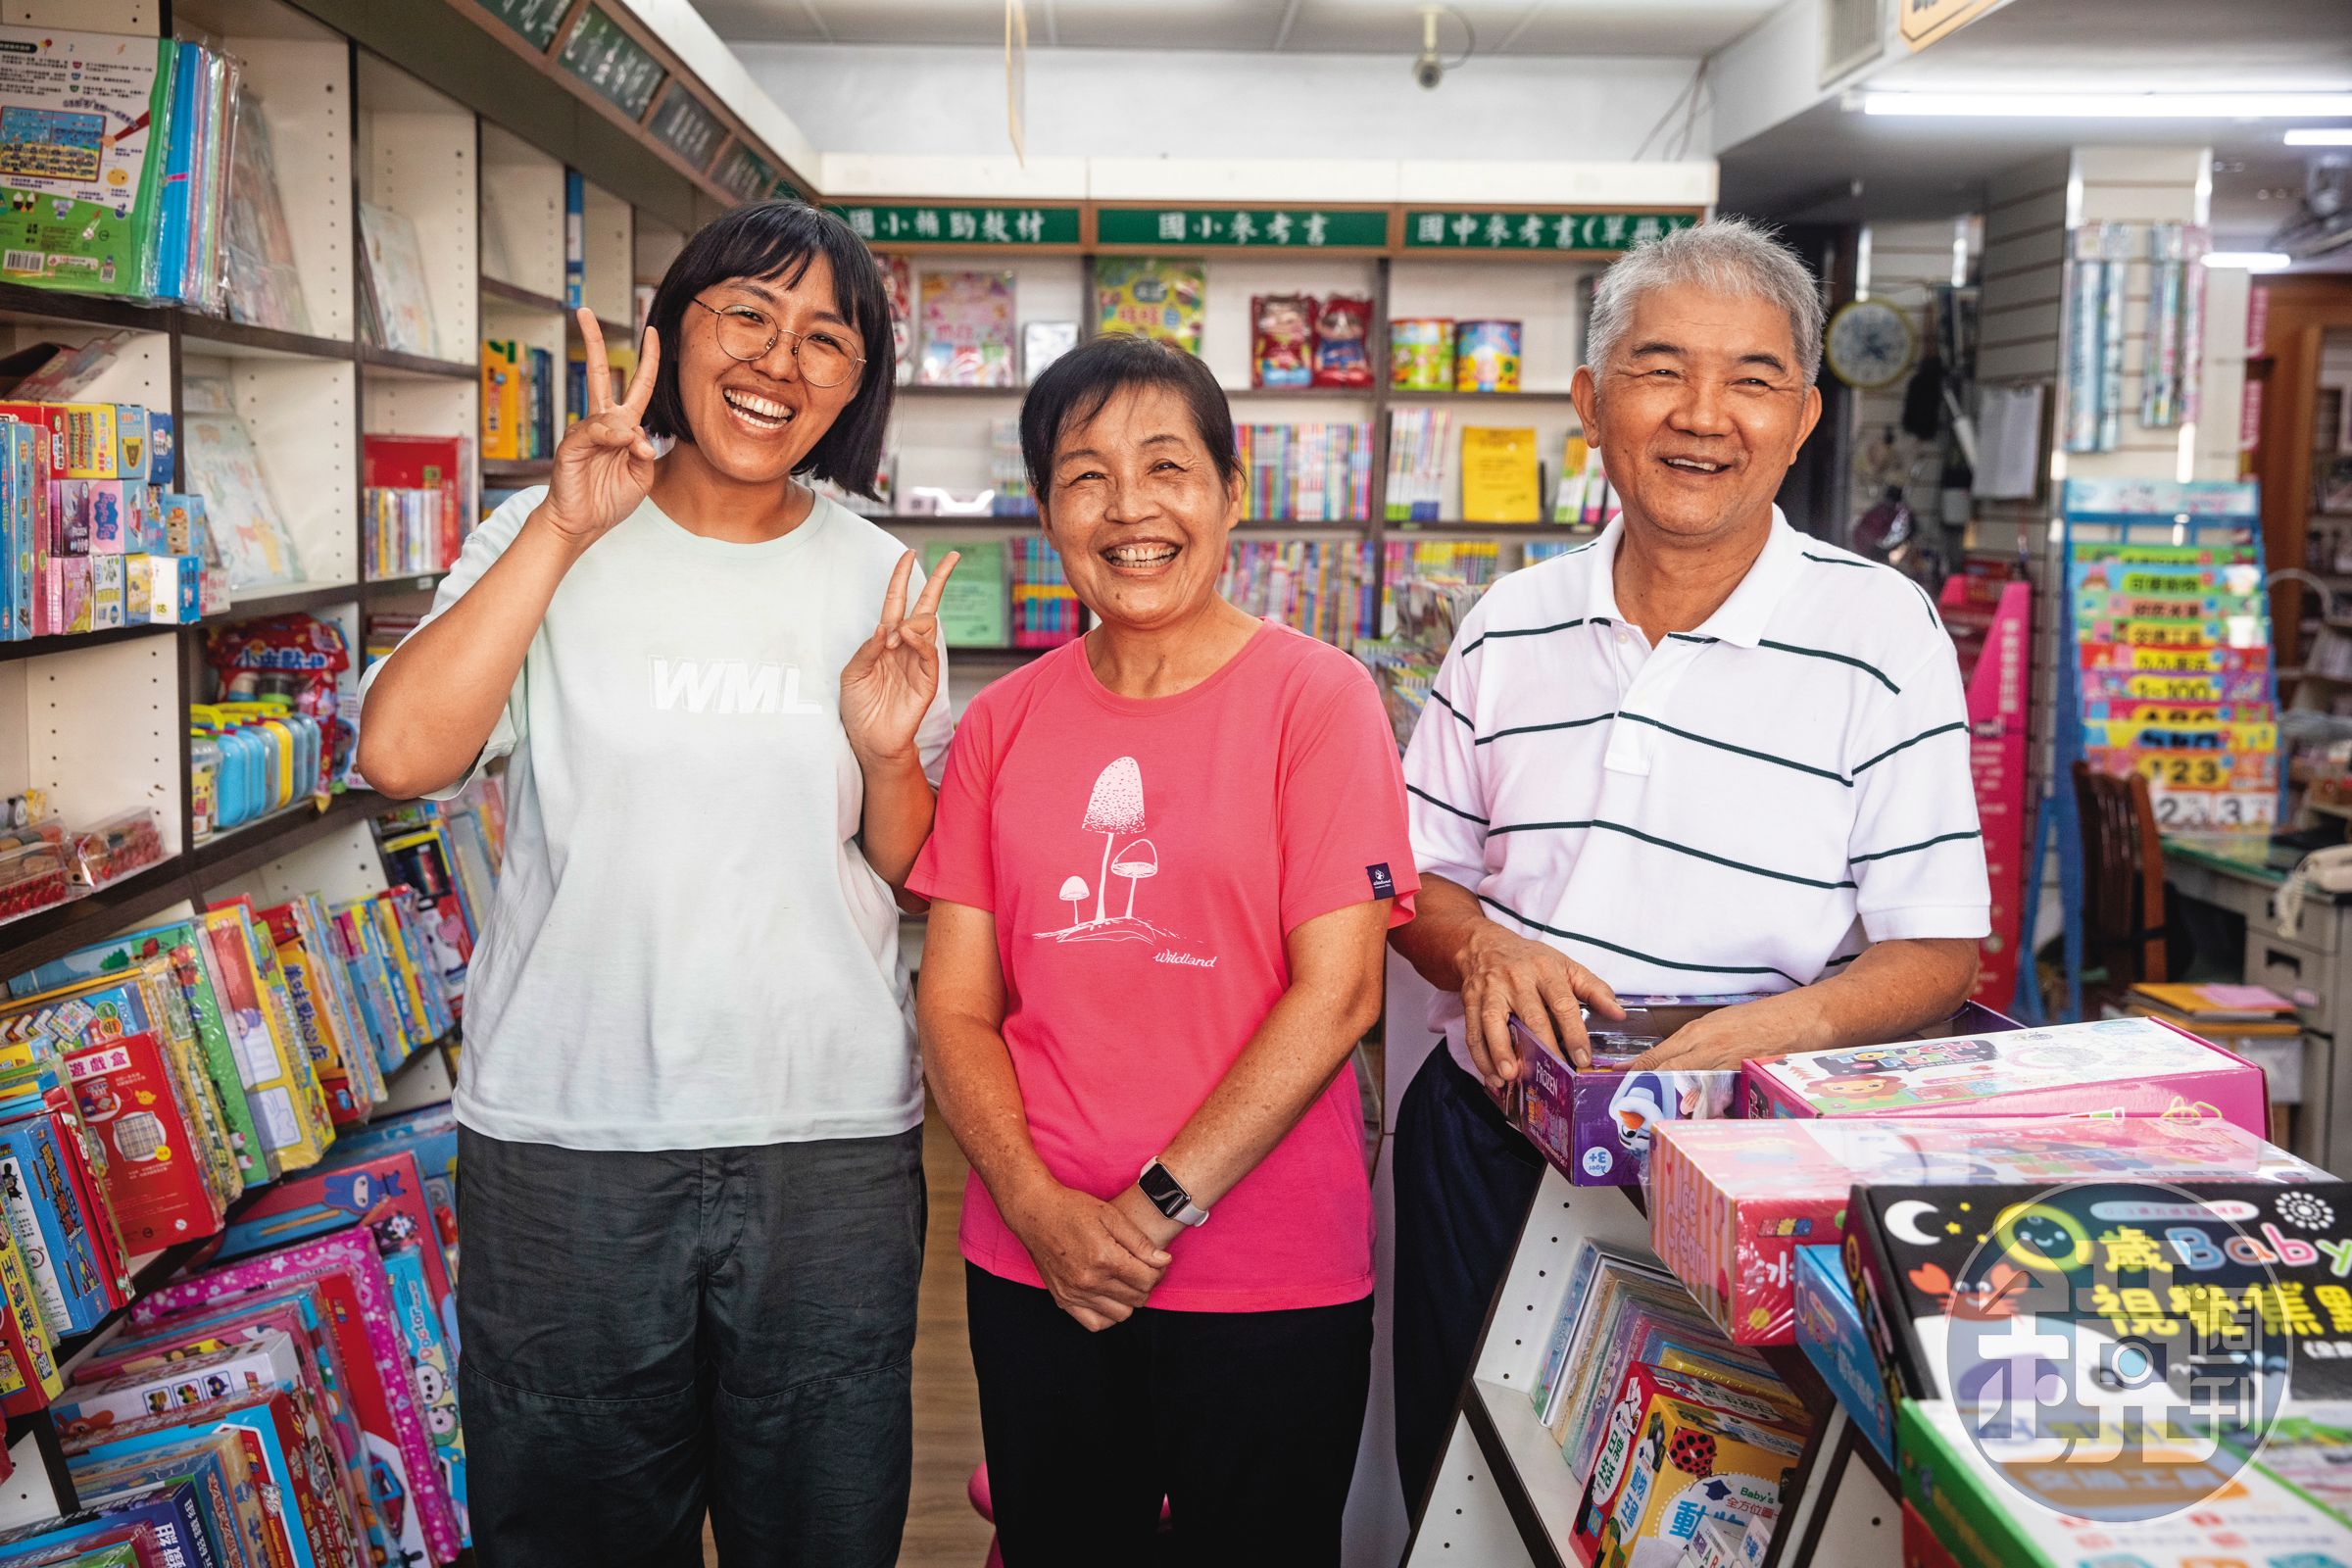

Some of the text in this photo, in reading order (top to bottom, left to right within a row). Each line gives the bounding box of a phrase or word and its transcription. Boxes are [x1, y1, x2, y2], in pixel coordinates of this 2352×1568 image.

[1158, 211, 1330, 246] 國小參考書
[648, 655, 823, 714] WML
[1152, 950, 1217, 969] Wildland
[1826, 1040, 1979, 1063] TOUCH
[1878, 1050, 1979, 1068] FEEL
[69, 1051, 127, 1078] 遊戲盒
[1536, 1060, 1558, 1100] FROZEN
[1589, 1152, 1607, 1163] 3+
[1589, 1164, 1606, 1174] Ages
[1740, 1486, 1775, 1504] Baby's
[1725, 1496, 1780, 1519] 全方位圖
